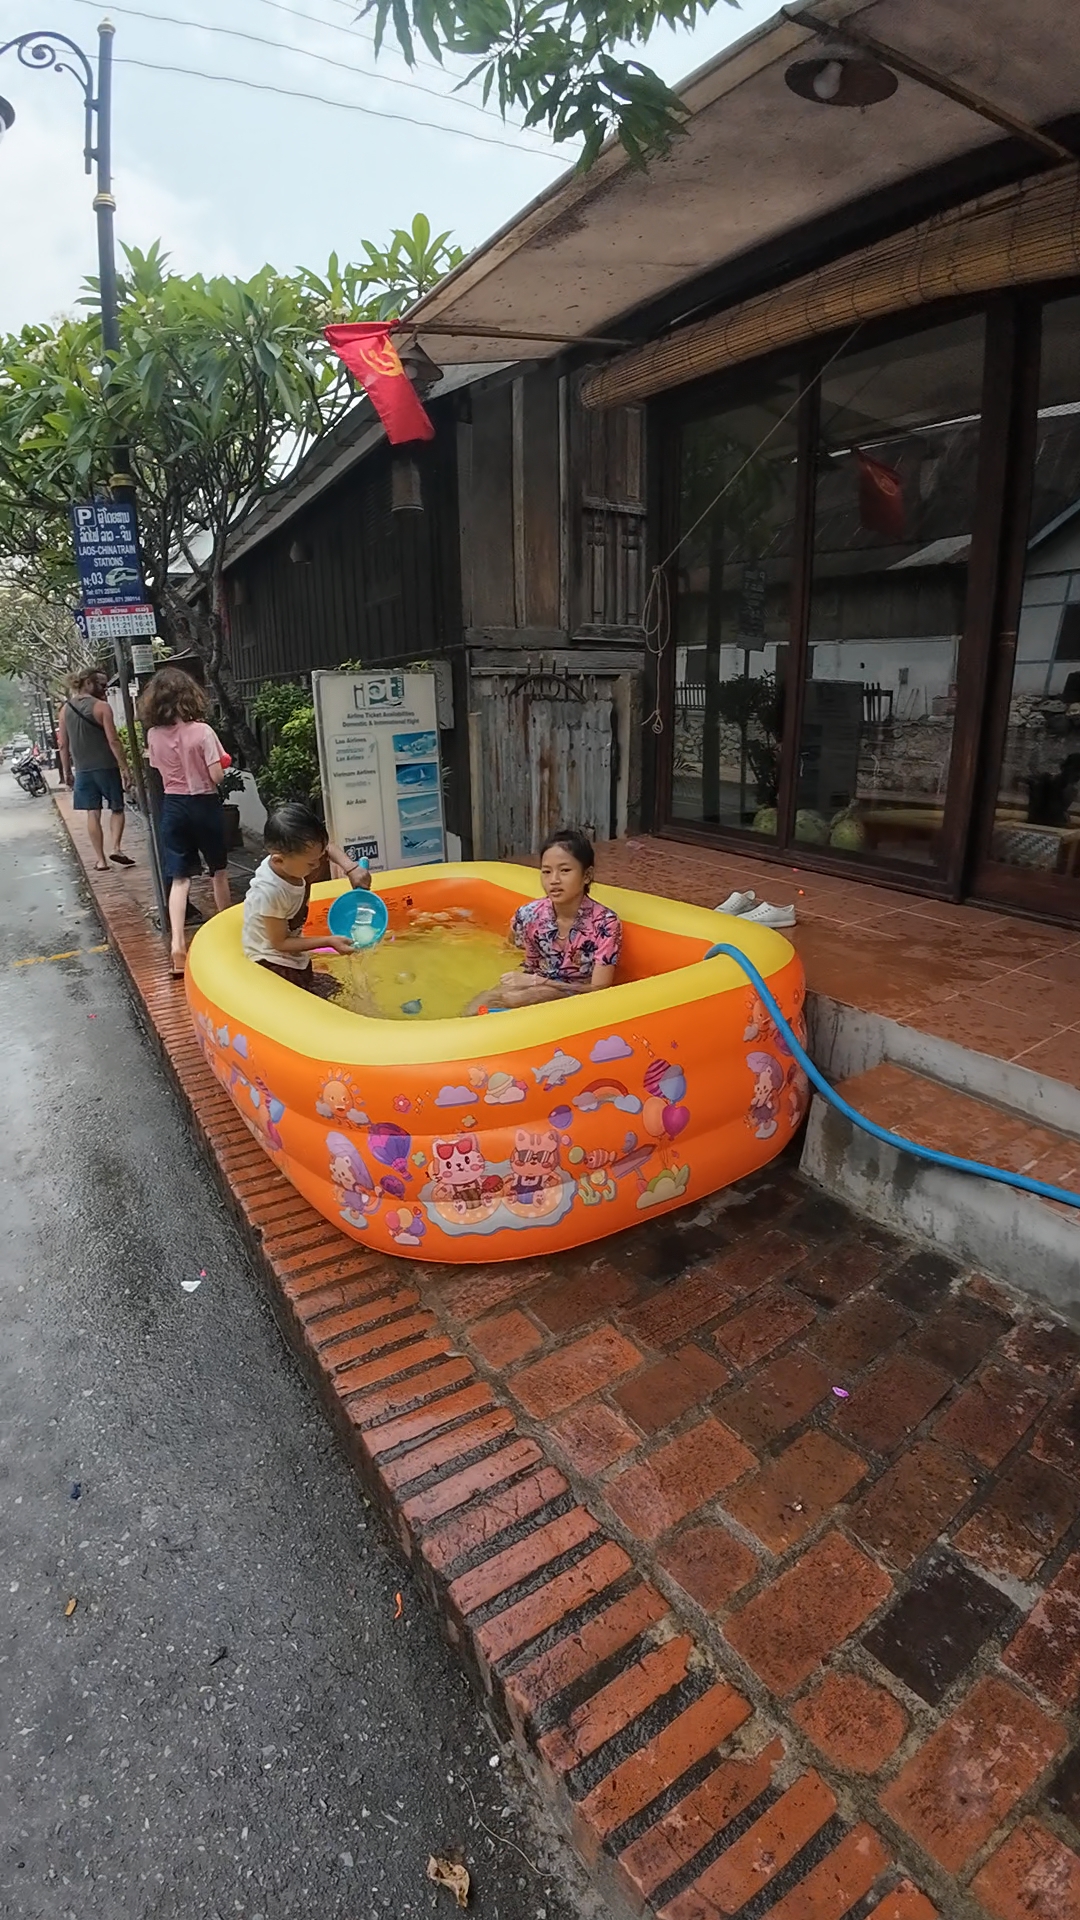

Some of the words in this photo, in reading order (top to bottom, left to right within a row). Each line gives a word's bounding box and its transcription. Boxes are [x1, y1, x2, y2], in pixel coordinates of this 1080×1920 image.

[77, 509, 92, 525] P
[78, 546, 118, 556] LAOS-CHINA
[116, 544, 136, 554] TRAIN
[93, 557, 125, 567] STATIONS
[76, 615, 87, 633] 3
[356, 845, 378, 857] THAI
